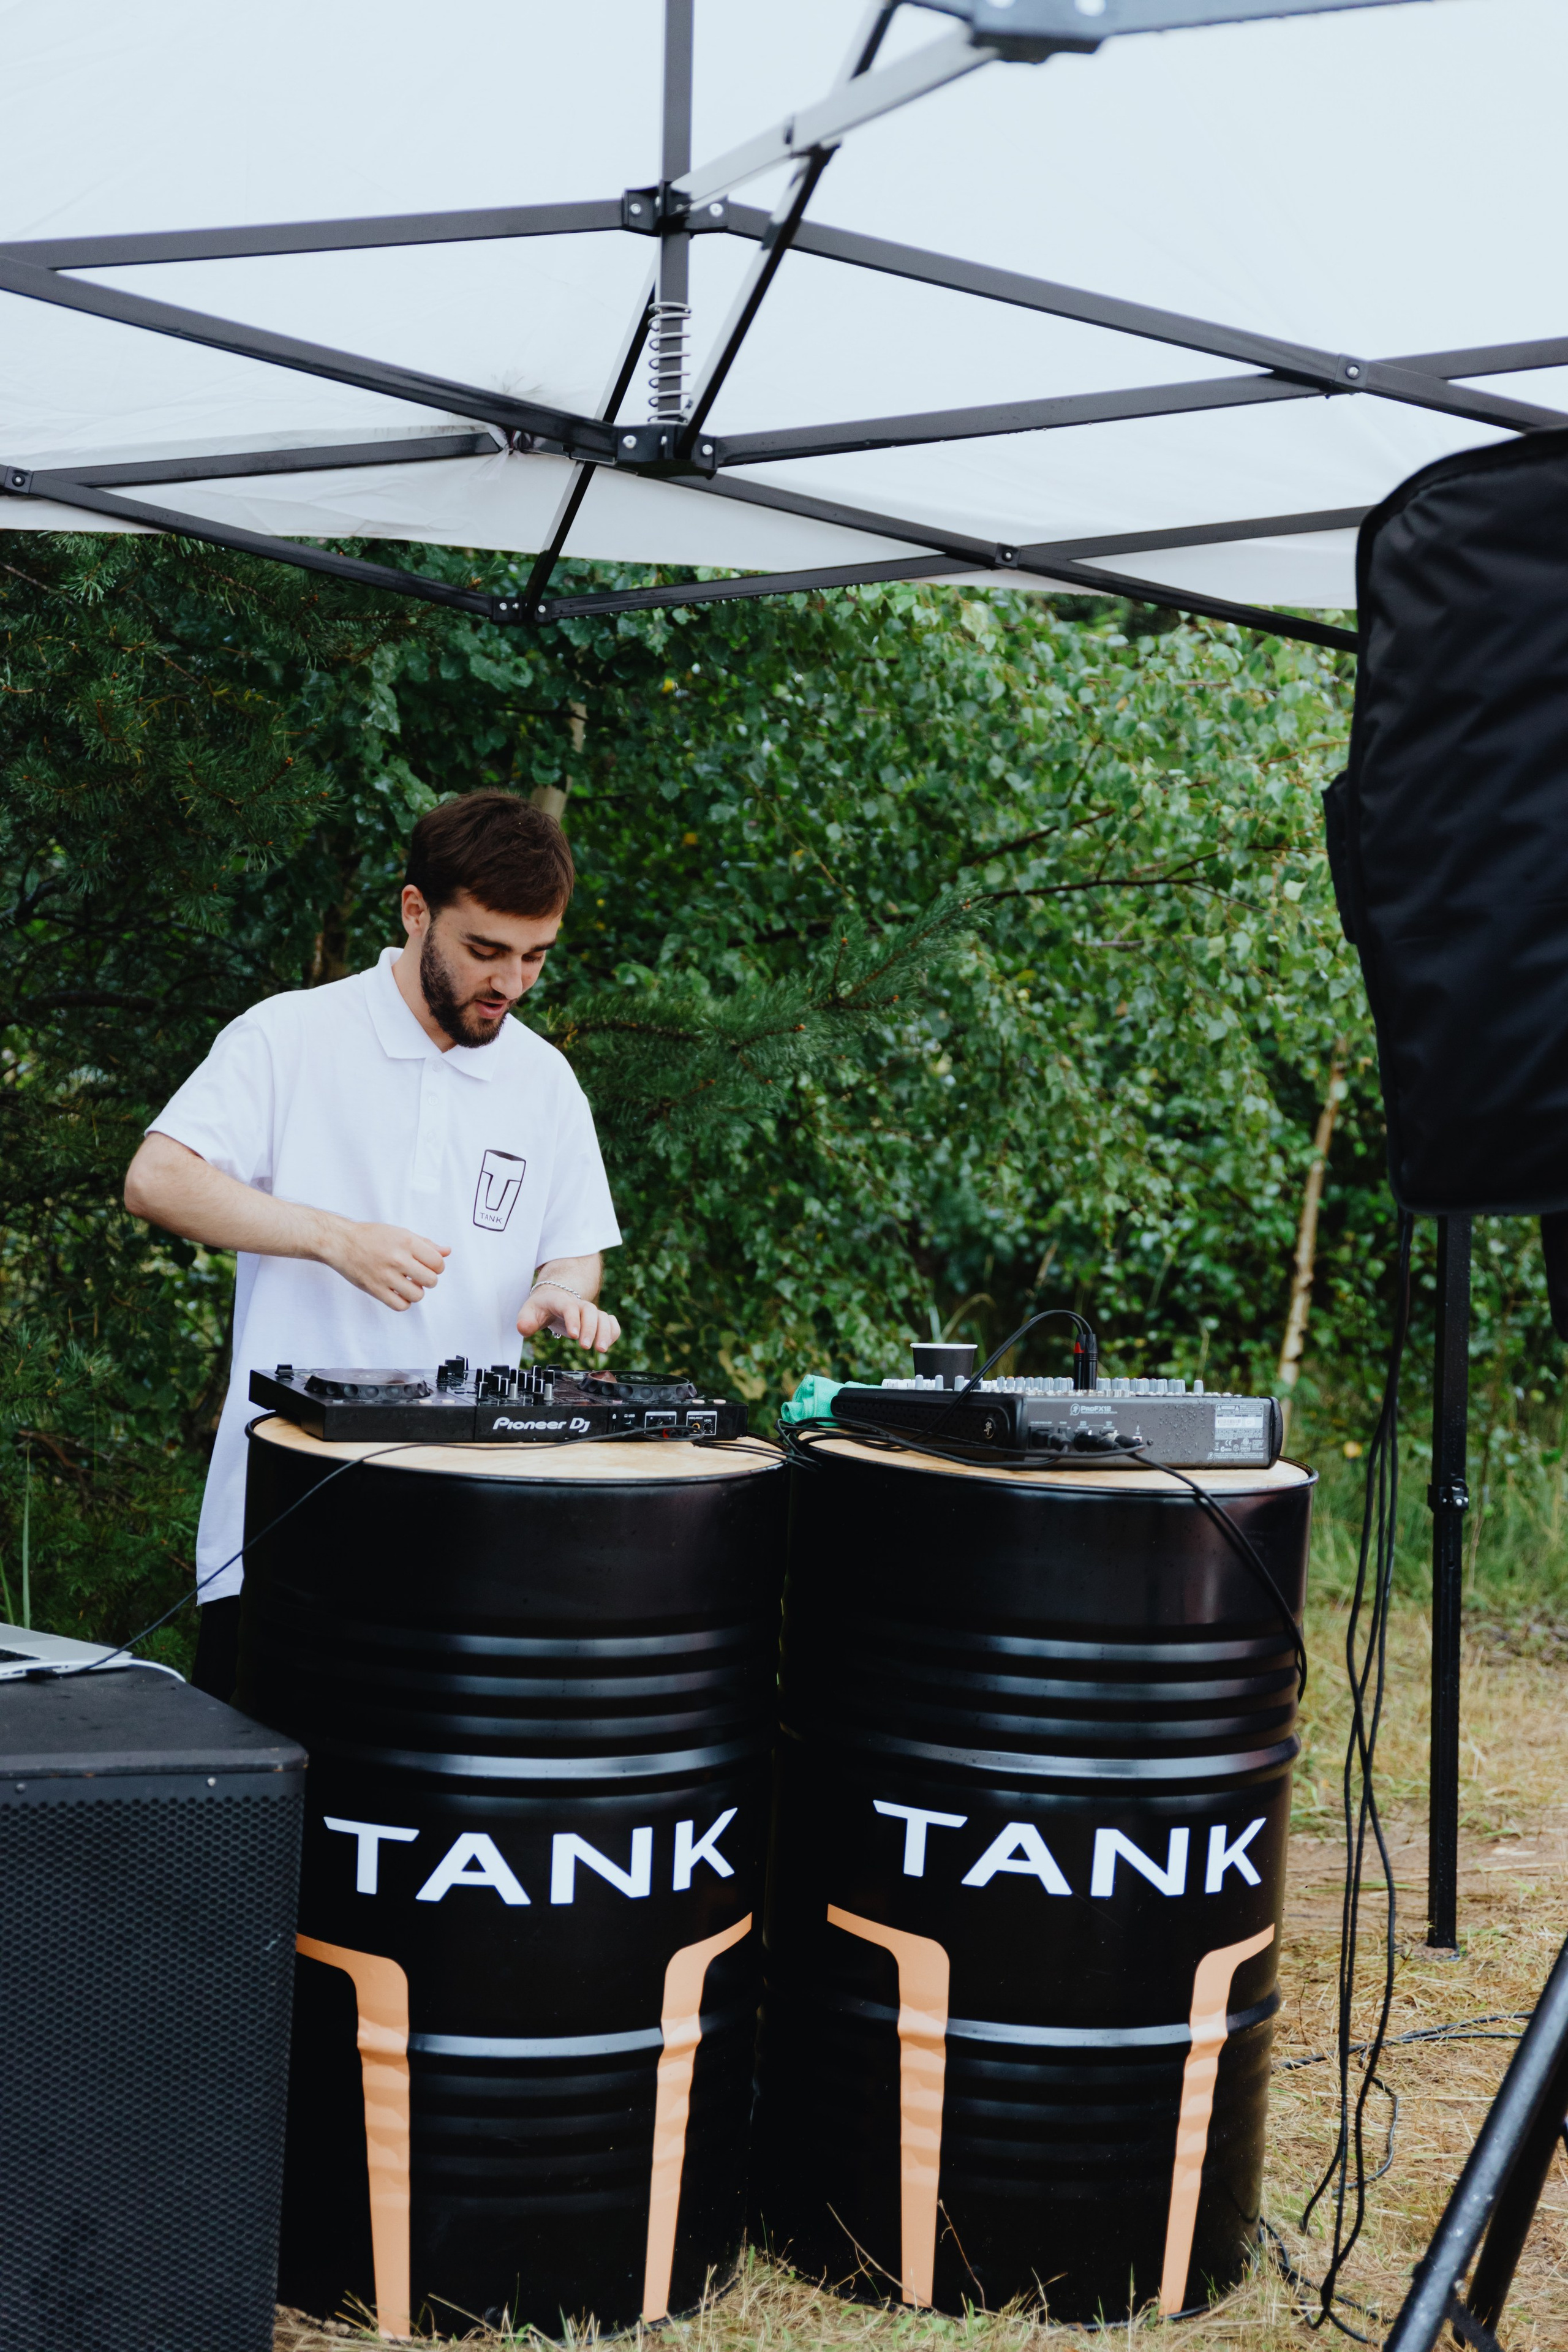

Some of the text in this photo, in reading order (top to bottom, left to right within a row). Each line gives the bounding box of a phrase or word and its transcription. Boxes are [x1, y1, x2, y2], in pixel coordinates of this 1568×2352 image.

[480, 1212, 503, 1224] TANK
[492, 1417, 567, 1430] Pioneer
[323, 1807, 738, 1905] TANK
[873, 1800, 1266, 1897] TANK
